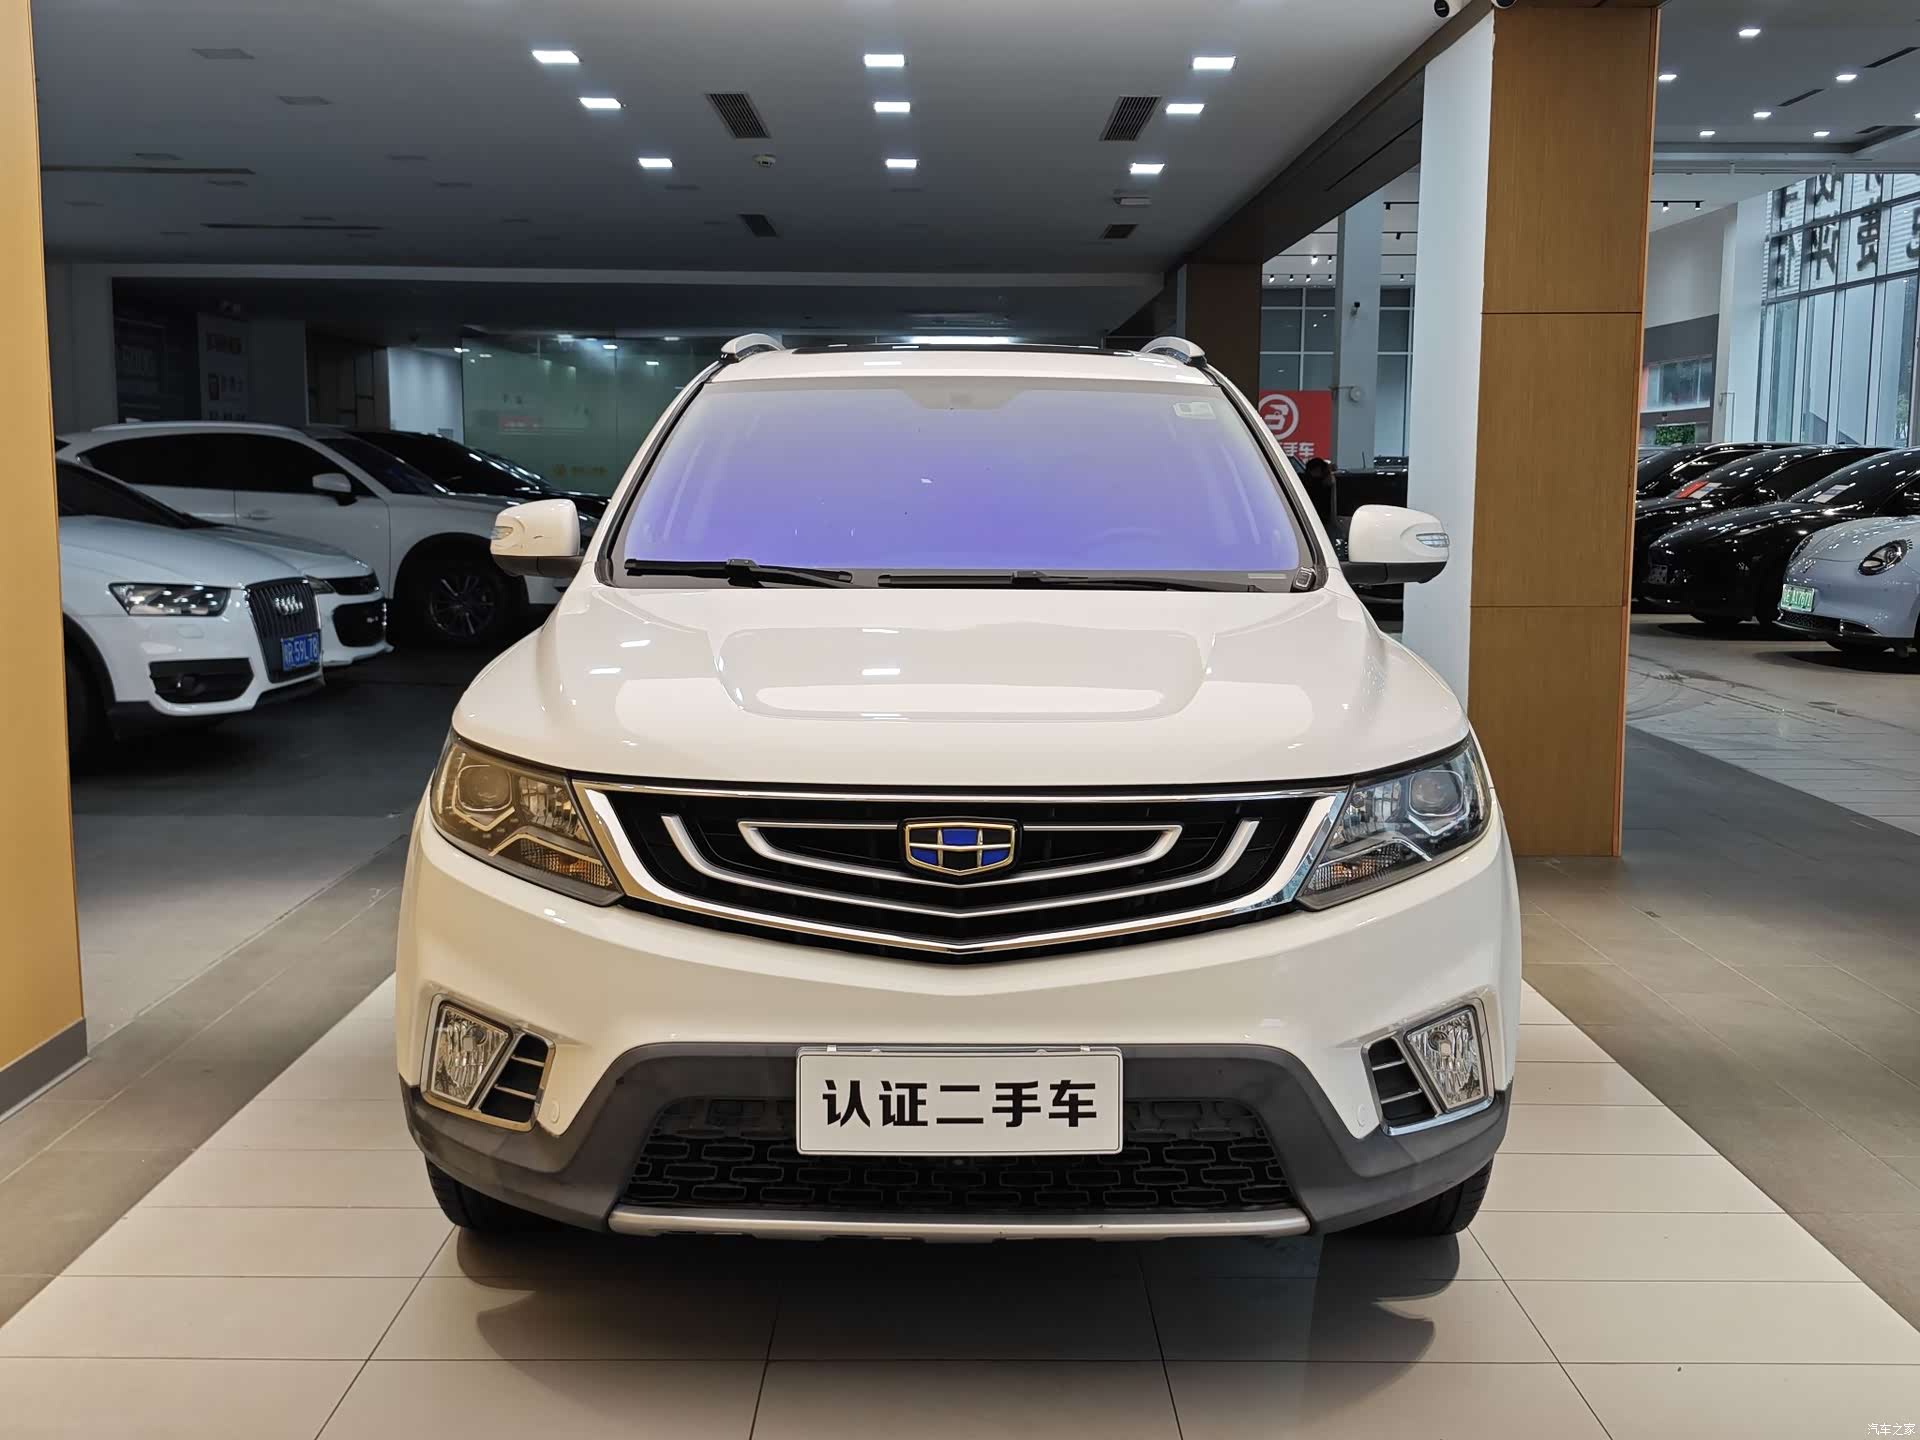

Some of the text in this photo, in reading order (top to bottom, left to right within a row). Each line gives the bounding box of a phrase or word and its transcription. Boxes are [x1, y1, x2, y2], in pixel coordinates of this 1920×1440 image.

[1280, 441, 1315, 457] 手车
[822, 1079, 1097, 1128] 认证二手车
